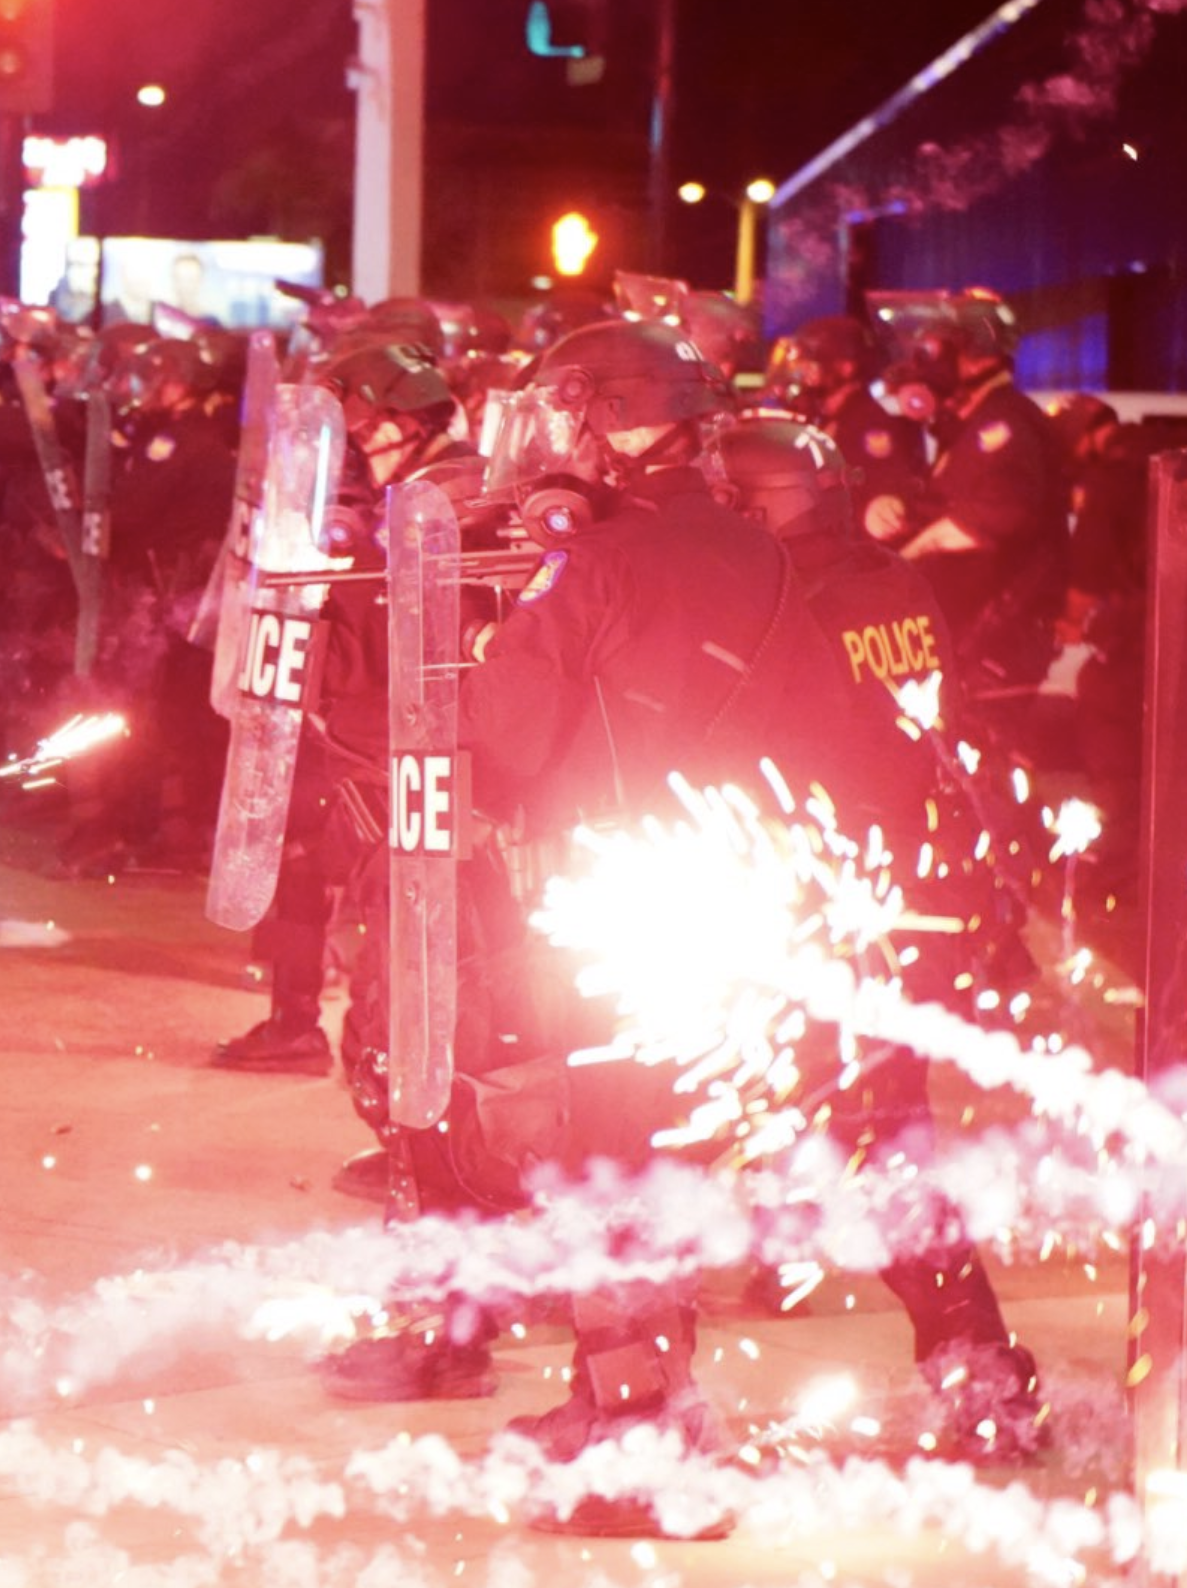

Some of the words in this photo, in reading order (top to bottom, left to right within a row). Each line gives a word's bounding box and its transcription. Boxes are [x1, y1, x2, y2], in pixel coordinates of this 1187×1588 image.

[238, 614, 311, 702] ICE
[842, 615, 940, 684] POLICE
[389, 755, 451, 852] ICE
